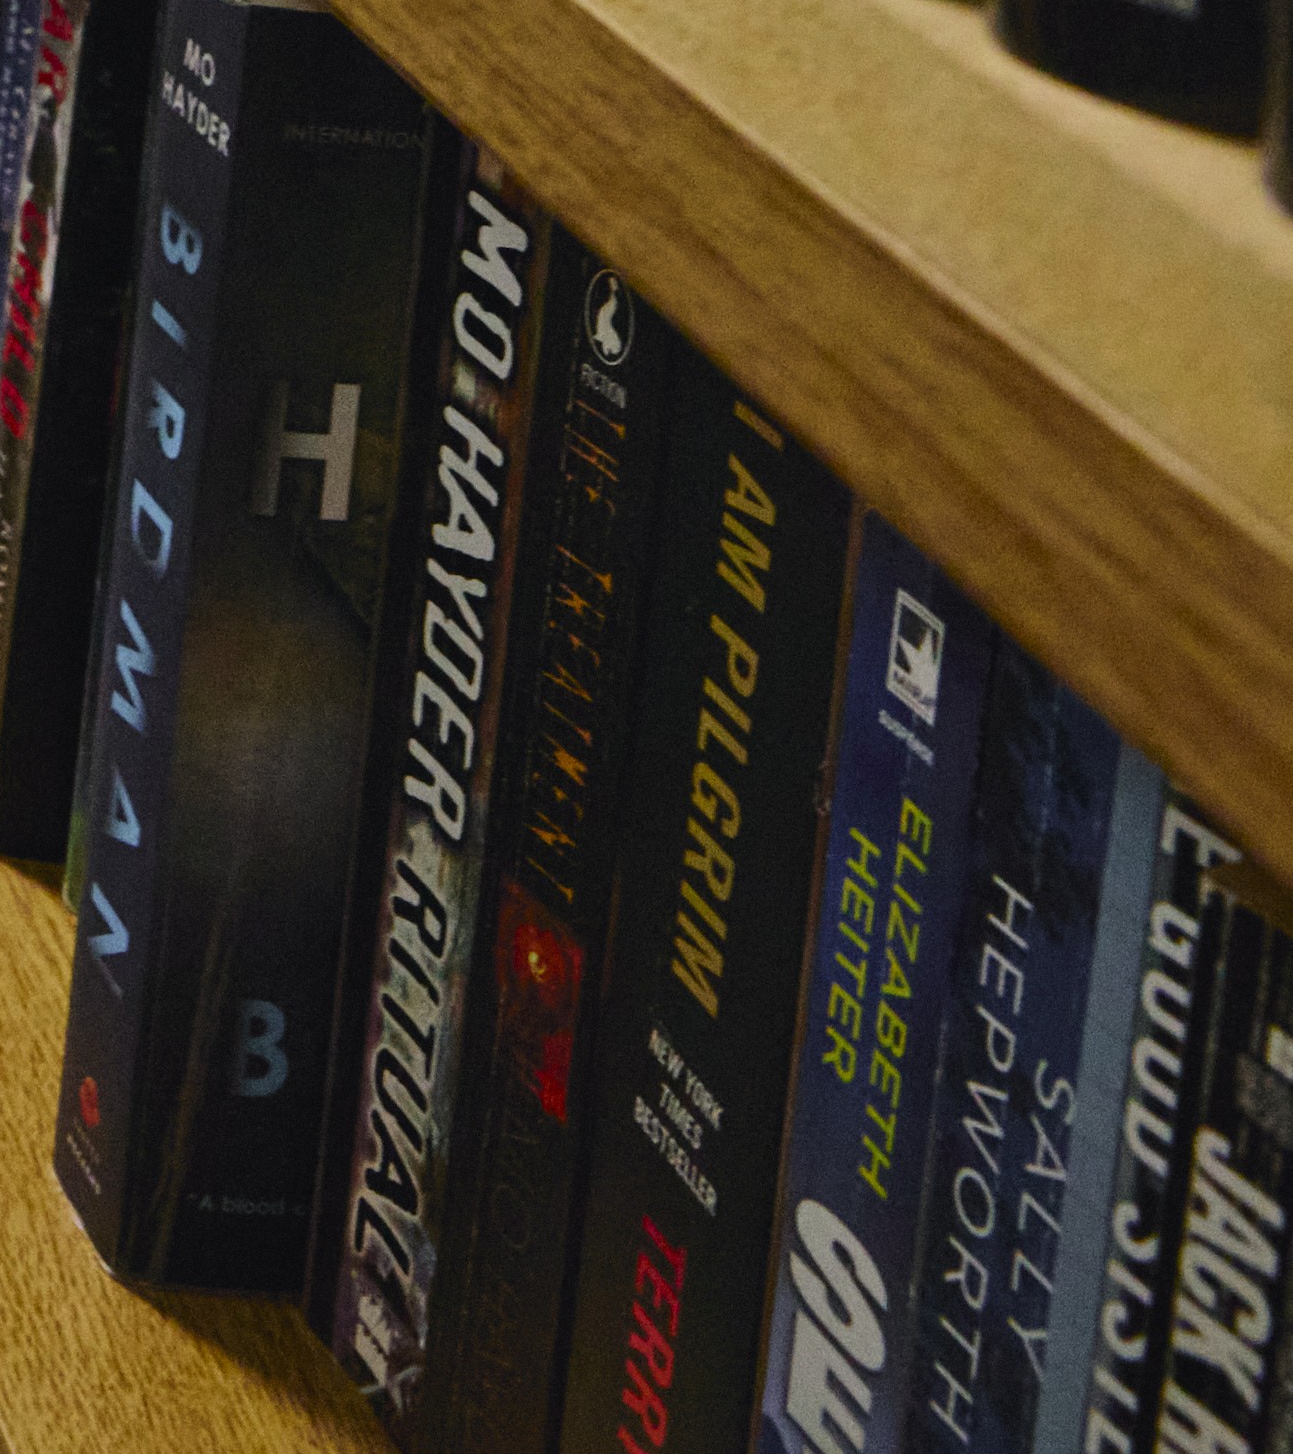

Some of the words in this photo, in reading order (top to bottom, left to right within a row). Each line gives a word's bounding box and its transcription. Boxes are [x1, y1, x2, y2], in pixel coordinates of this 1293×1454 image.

[159, 69, 232, 159] HAYDER
[183, 38, 216, 88] MO
[451, 188, 530, 381] MO
[86, 200, 204, 1002] BIRDMAN
[403, 403, 505, 843] HAYDER
[709, 452, 777, 617] AM
[670, 613, 761, 1022] PILGRIM
[817, 824, 884, 1088] HEITER
[349, 857, 448, 1305] RITUAL
[647, 1028, 684, 1080] NEW
[684, 1068, 725, 1131] YORK
[660, 1082, 704, 1151] TIMES
[854, 792, 934, 1201] ELIZABETH
[633, 1094, 718, 1218] BESTSELLER
[930, 872, 1034, 1448] HEPWORTH
[1009, 1059, 1078, 1387] SALLY
[1170, 1123, 1286, 1415] JACK
